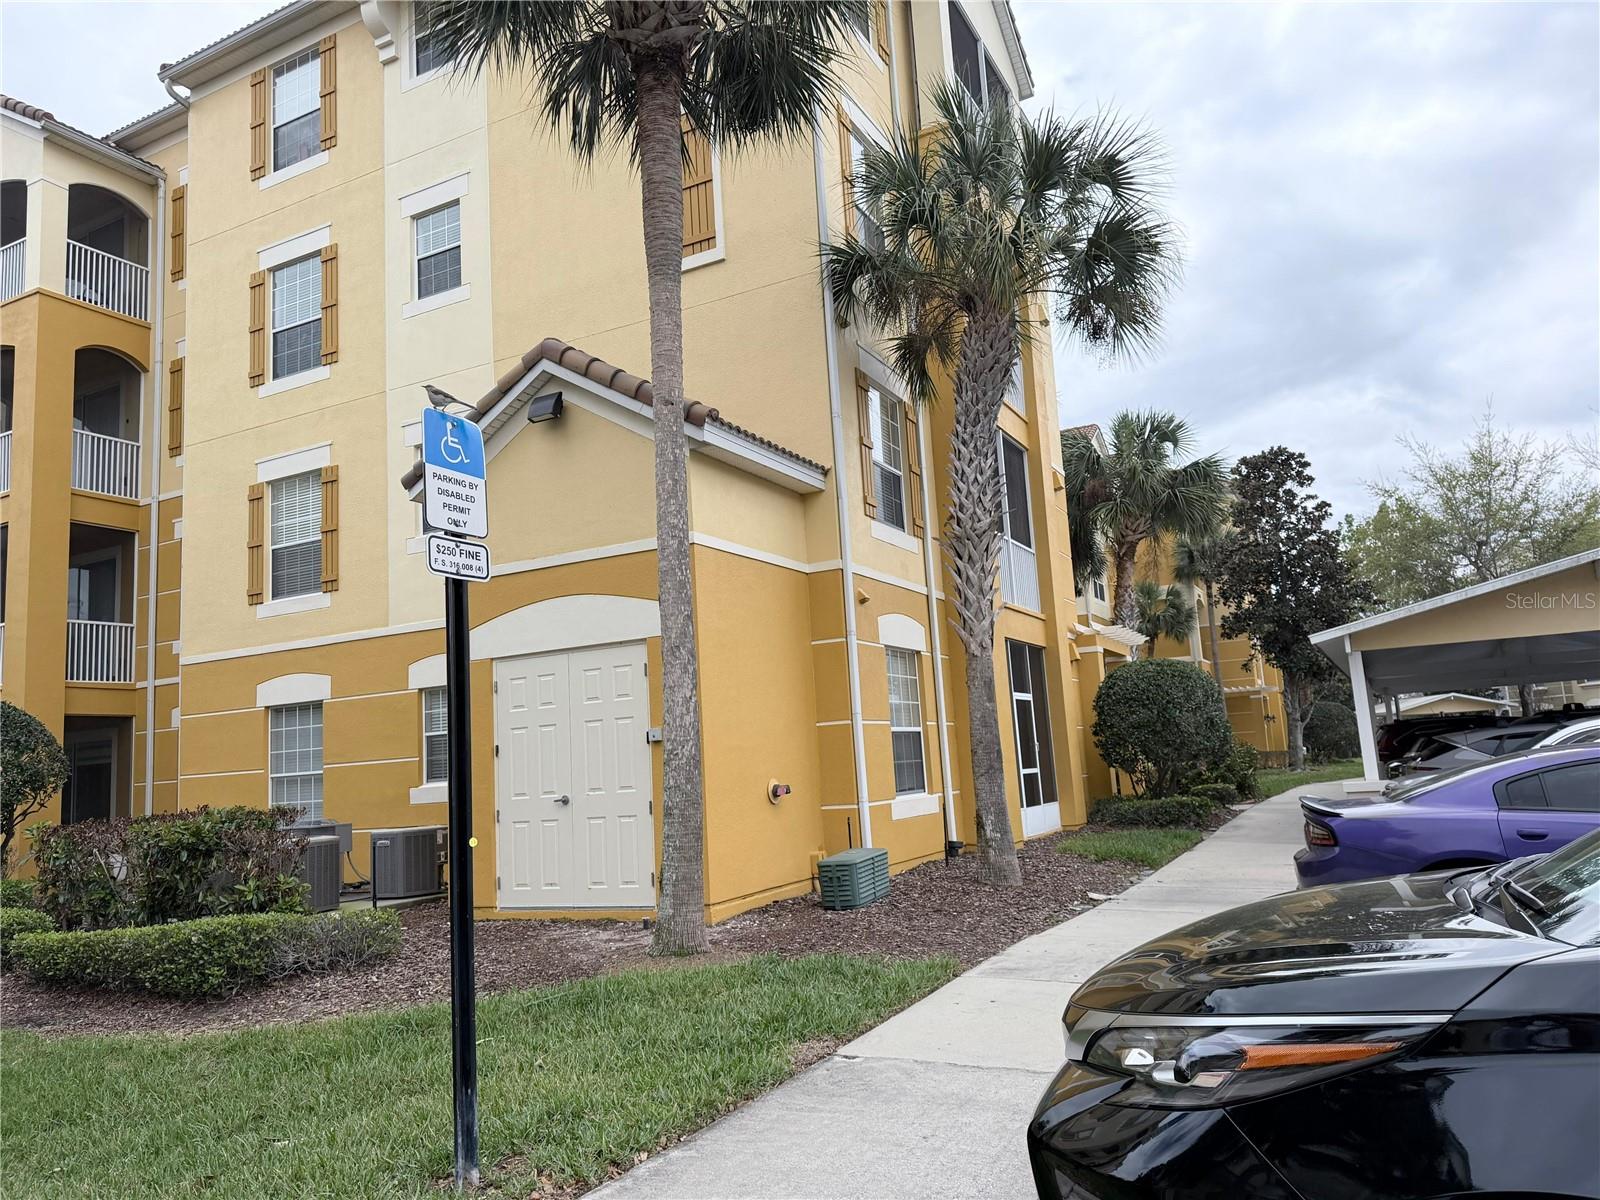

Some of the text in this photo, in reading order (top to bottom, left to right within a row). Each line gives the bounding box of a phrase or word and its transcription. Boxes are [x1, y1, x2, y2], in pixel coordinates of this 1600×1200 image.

[433, 472, 479, 491] PARKING BY
[437, 487, 475, 503] DISABLED
[443, 503, 471, 516] PERMIT
[447, 517, 468, 528] ONLY
[436, 543, 481, 561] $250 FINE
[434, 558, 440, 566] F.
[441, 559, 448, 567] S.
[475, 564, 484, 574] (4)
